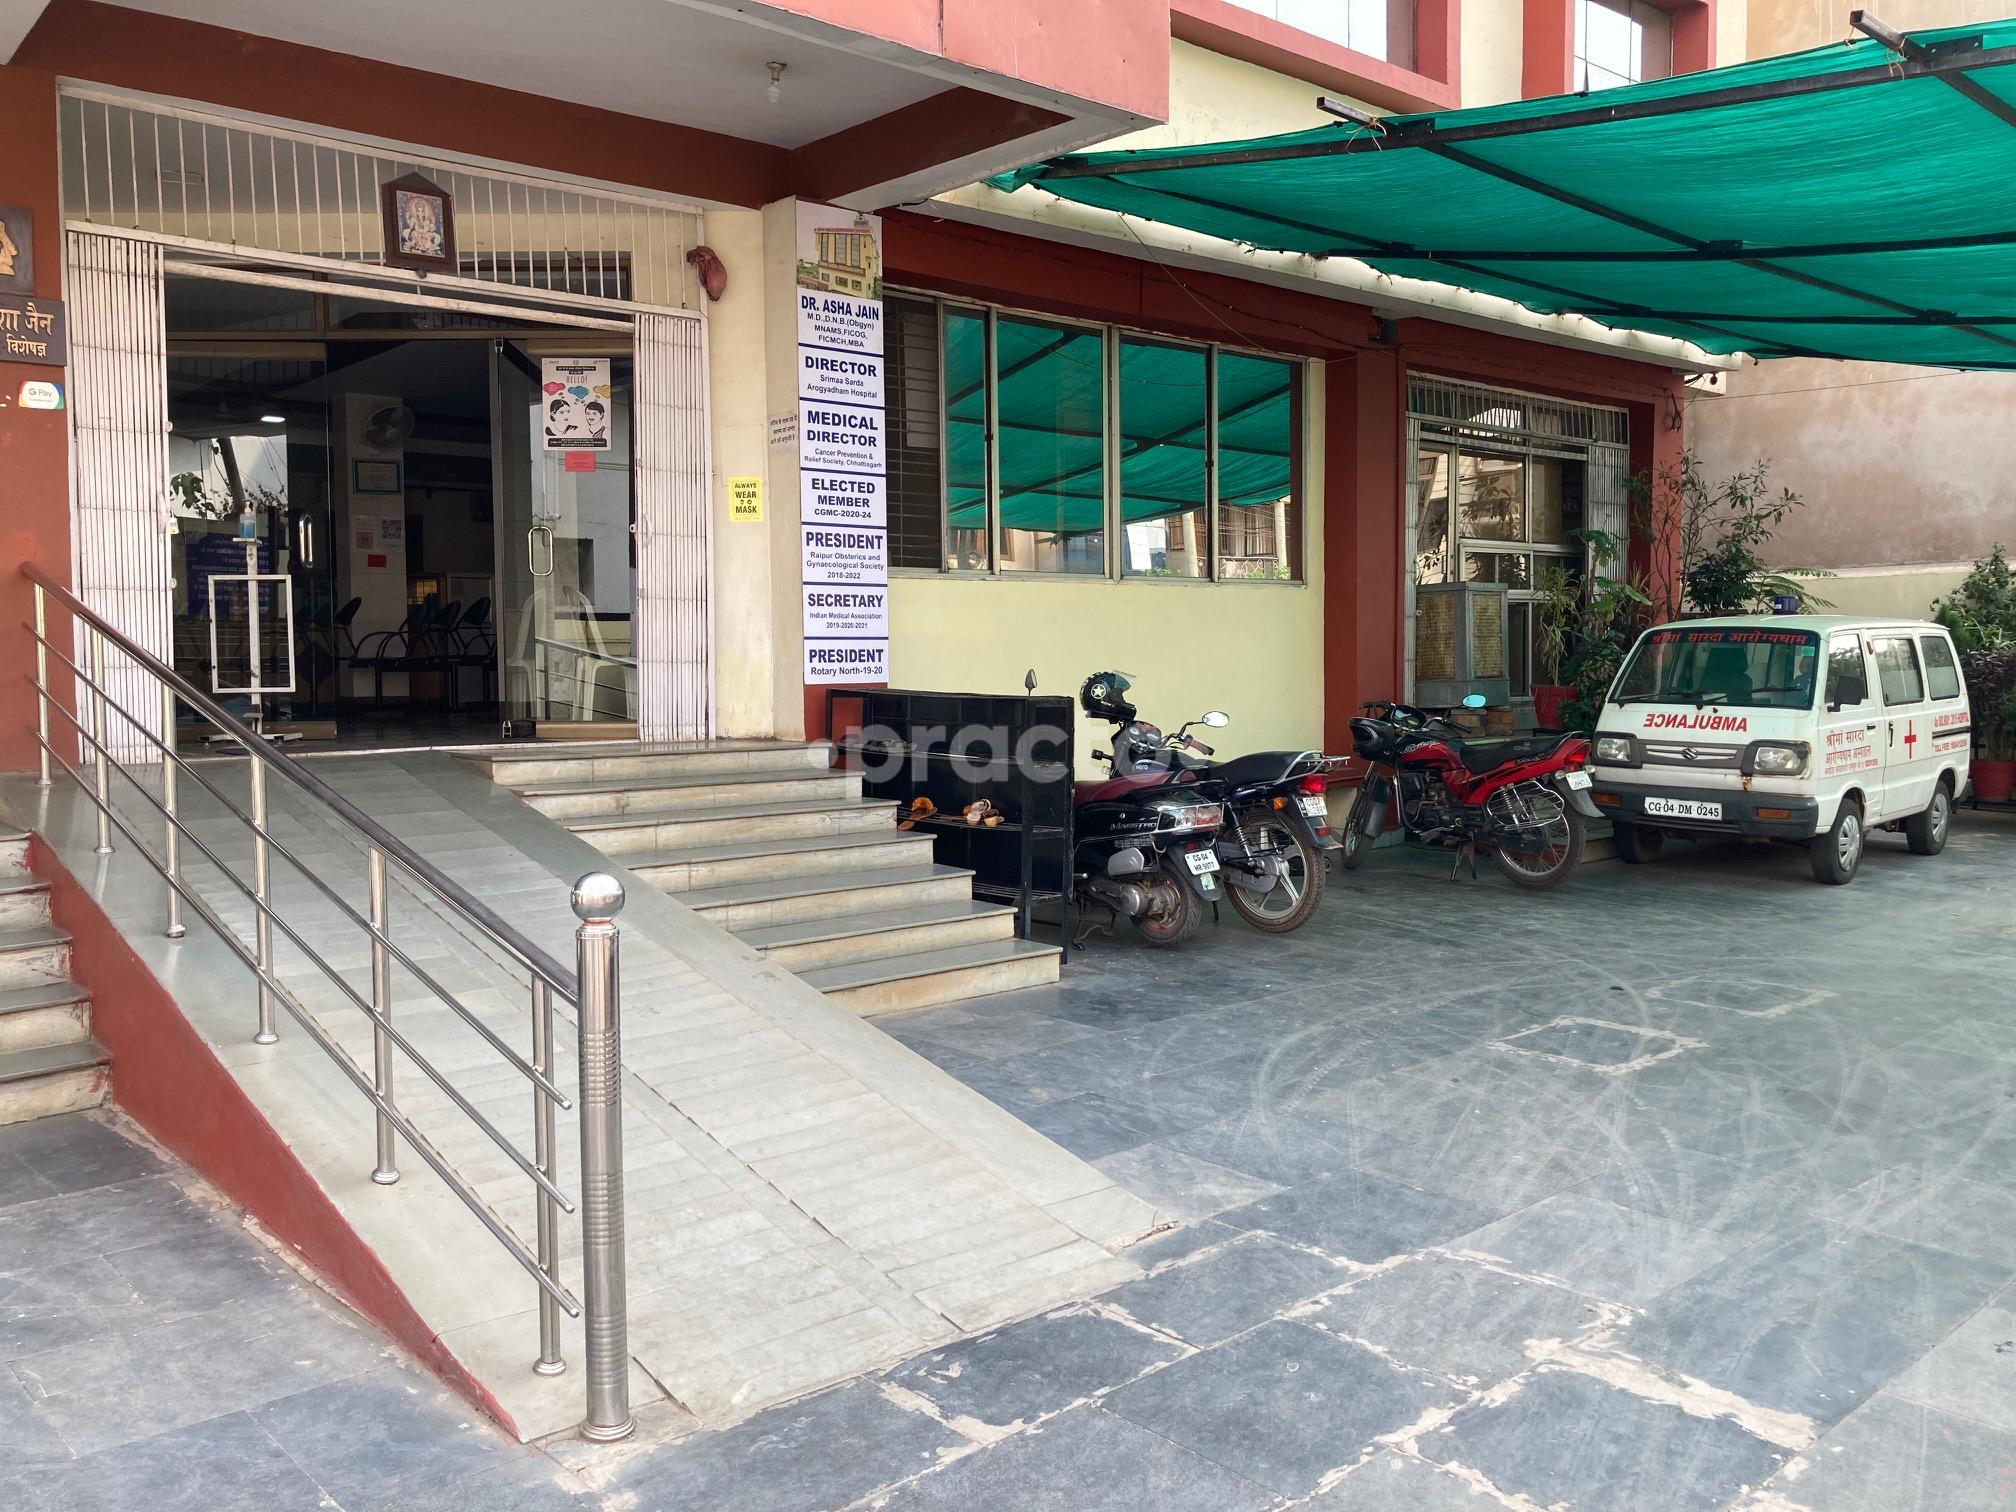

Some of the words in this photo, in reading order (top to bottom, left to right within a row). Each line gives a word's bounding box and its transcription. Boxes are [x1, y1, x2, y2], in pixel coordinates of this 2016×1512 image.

[801, 295, 819, 311] DR.
[823, 299, 852, 317] ASHA
[855, 304, 879, 321] JAIN
[25, 301, 54, 336] जैन
[6, 333, 47, 358] विशेषज्ञ
[818, 335, 865, 348] FICMCH,MBA
[805, 355, 877, 378] DIRECTOR
[820, 374, 844, 385] Srimaa
[845, 377, 864, 387] Sarda
[38, 389, 52, 398] Pay
[807, 383, 849, 395] Arogyadham
[850, 388, 878, 399] Hospital
[807, 410, 878, 431] MEDICAL
[807, 430, 877, 448] DIRECTOR
[815, 448, 836, 457] Cancer
[837, 450, 868, 460] Prevention
[811, 477, 876, 494] ELECTED
[735, 490, 757, 499] WEAR
[817, 494, 870, 508] MEMBER
[735, 505, 757, 514] MASK
[814, 508, 872, 519] CGMC-2020-24
[806, 531, 884, 550] PRESIDENT
[810, 551, 833, 560] Raipur
[806, 560, 858, 570] Gynaecological
[859, 562, 885, 571] Society
[827, 571, 861, 579] 2018-2022
[808, 593, 884, 608] SECRETARY
[850, 612, 882, 620] Association
[826, 621, 868, 629] 2019-2020-2021
[809, 648, 884, 664] PRESIDENT
[811, 667, 837, 677] Rotary
[839, 666, 883, 675] North-19-20
[1648, 801, 1661, 812] CG
[1663, 802, 1675, 813] 04
[1678, 804, 1693, 815] DM
[1696, 805, 1720, 818] 0245
[1193, 854, 1201, 862] CG
